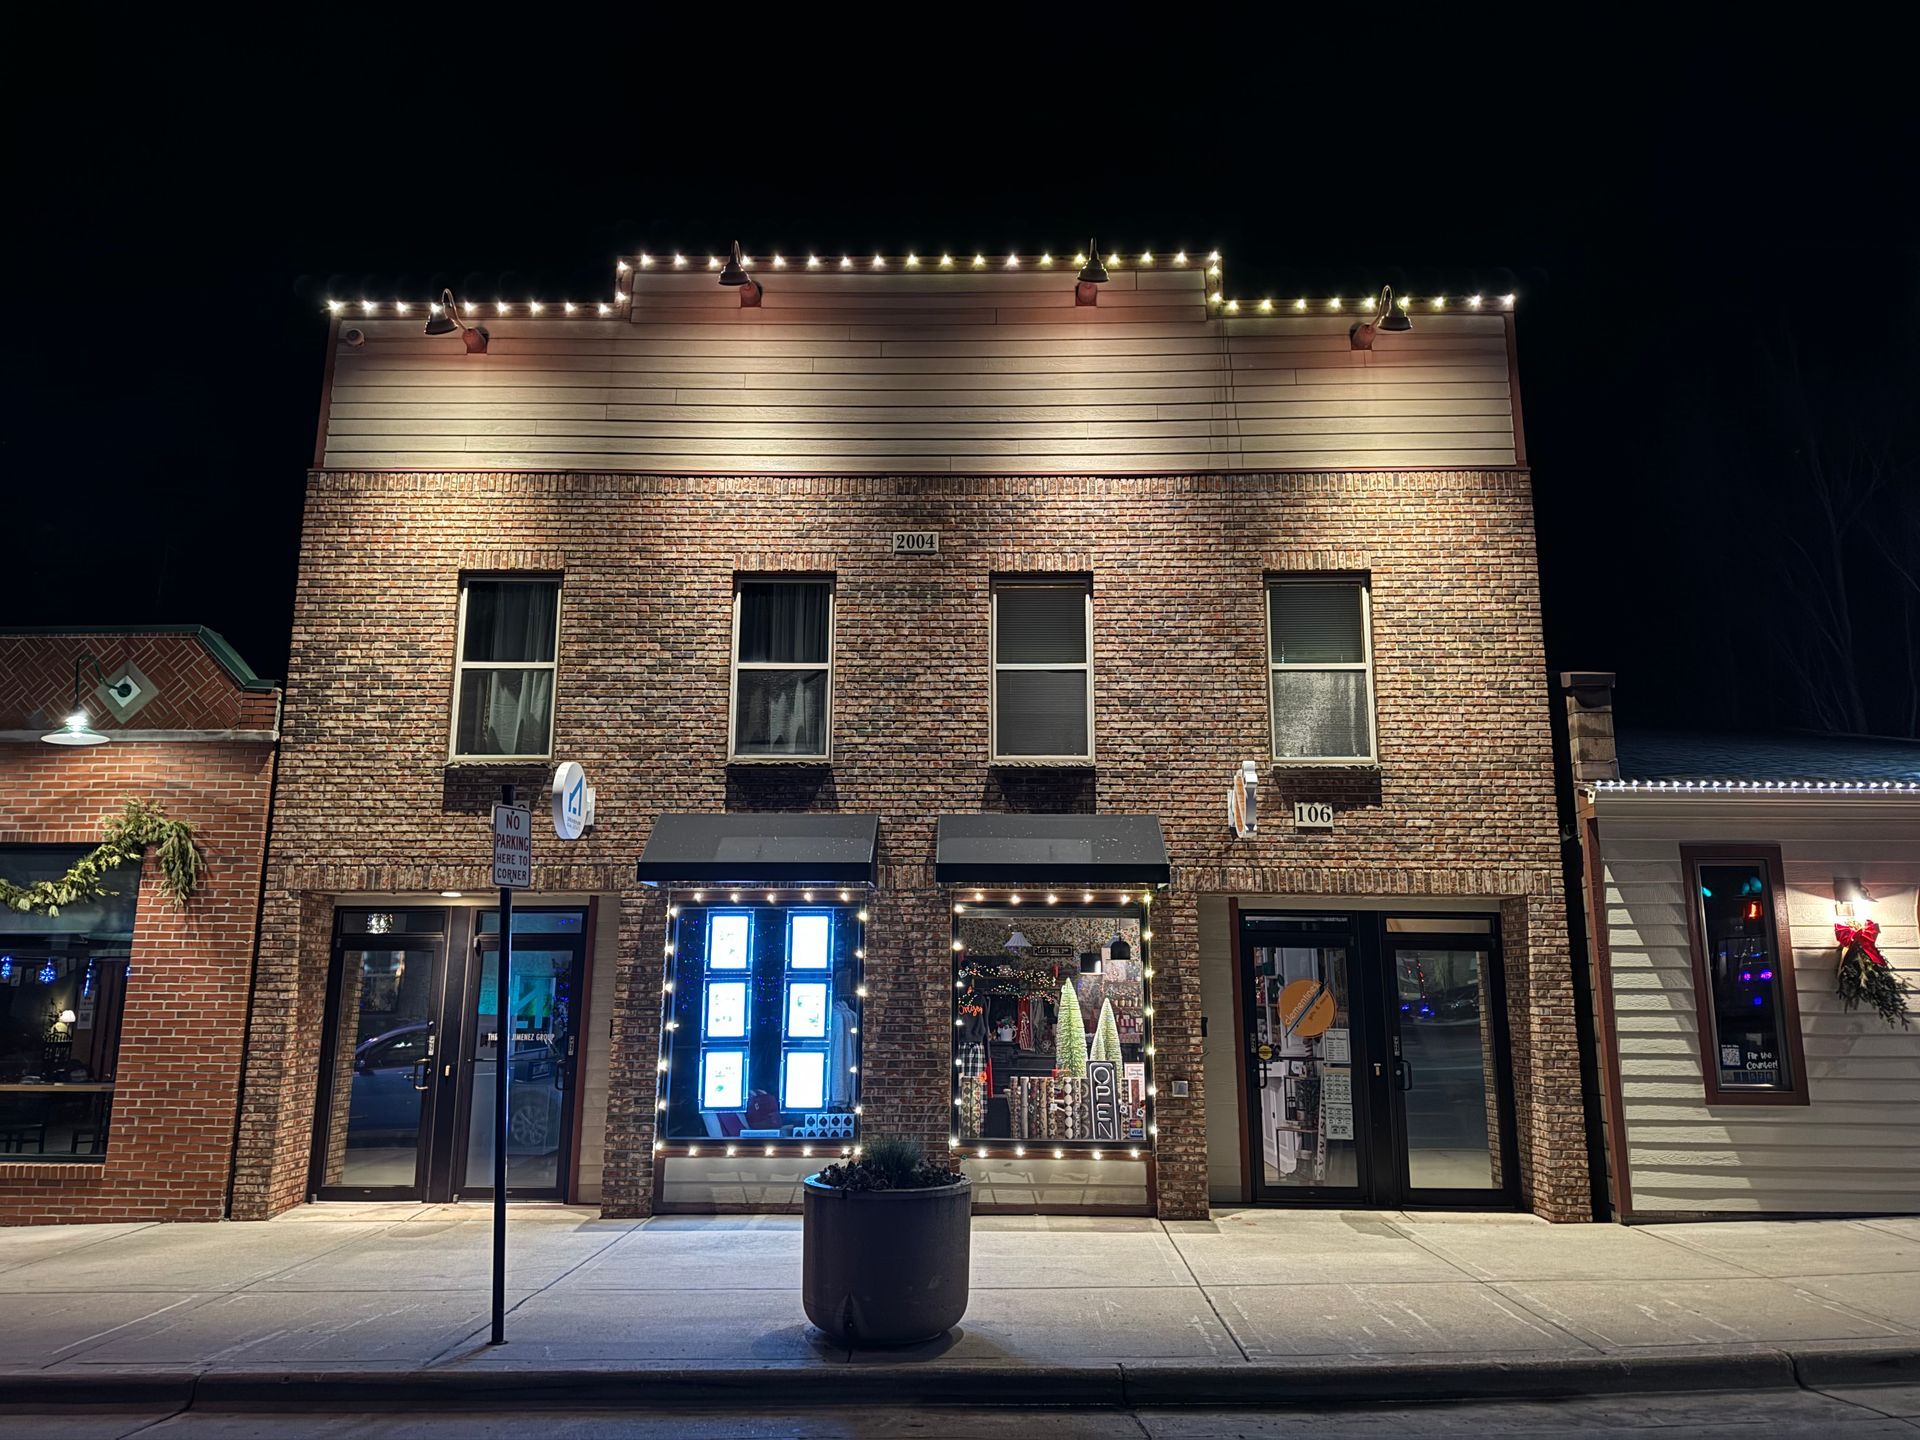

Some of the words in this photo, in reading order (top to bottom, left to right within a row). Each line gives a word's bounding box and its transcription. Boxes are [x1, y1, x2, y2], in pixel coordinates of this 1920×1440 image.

[896, 534, 935, 549] 2004
[506, 814, 520, 830] NO
[1297, 806, 1331, 823] 106
[496, 834, 529, 851] PARKING
[496, 854, 516, 865] HERE
[519, 856, 528, 866] TO
[497, 868, 527, 881] CORNER
[1285, 981, 1322, 1025] clementines
[511, 1033, 534, 1041] JIMENEZ
[535, 1033, 555, 1041] GROUP
[1093, 1066, 1113, 1140] OPEN
